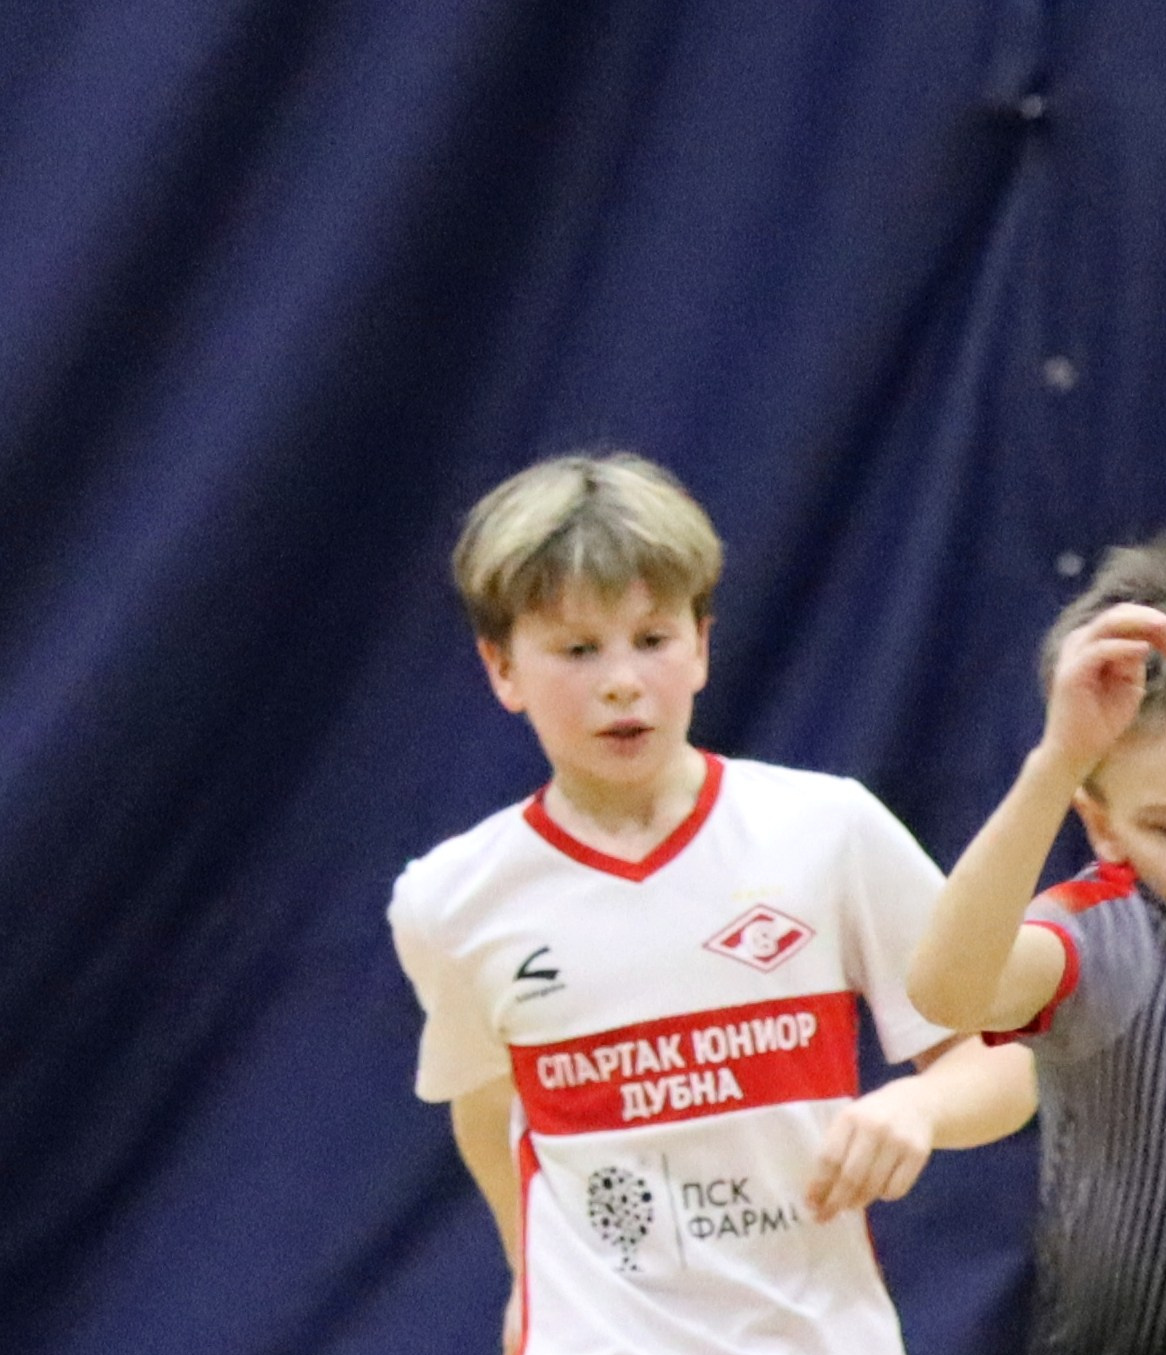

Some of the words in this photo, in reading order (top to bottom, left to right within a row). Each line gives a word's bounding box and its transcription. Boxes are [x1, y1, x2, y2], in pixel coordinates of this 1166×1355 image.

[536, 1033, 686, 1090] СПАРТАК
[691, 1012, 817, 1065] ЮНИОР
[619, 1067, 743, 1121] ДУБНА
[682, 1177, 751, 1209] ПСК
